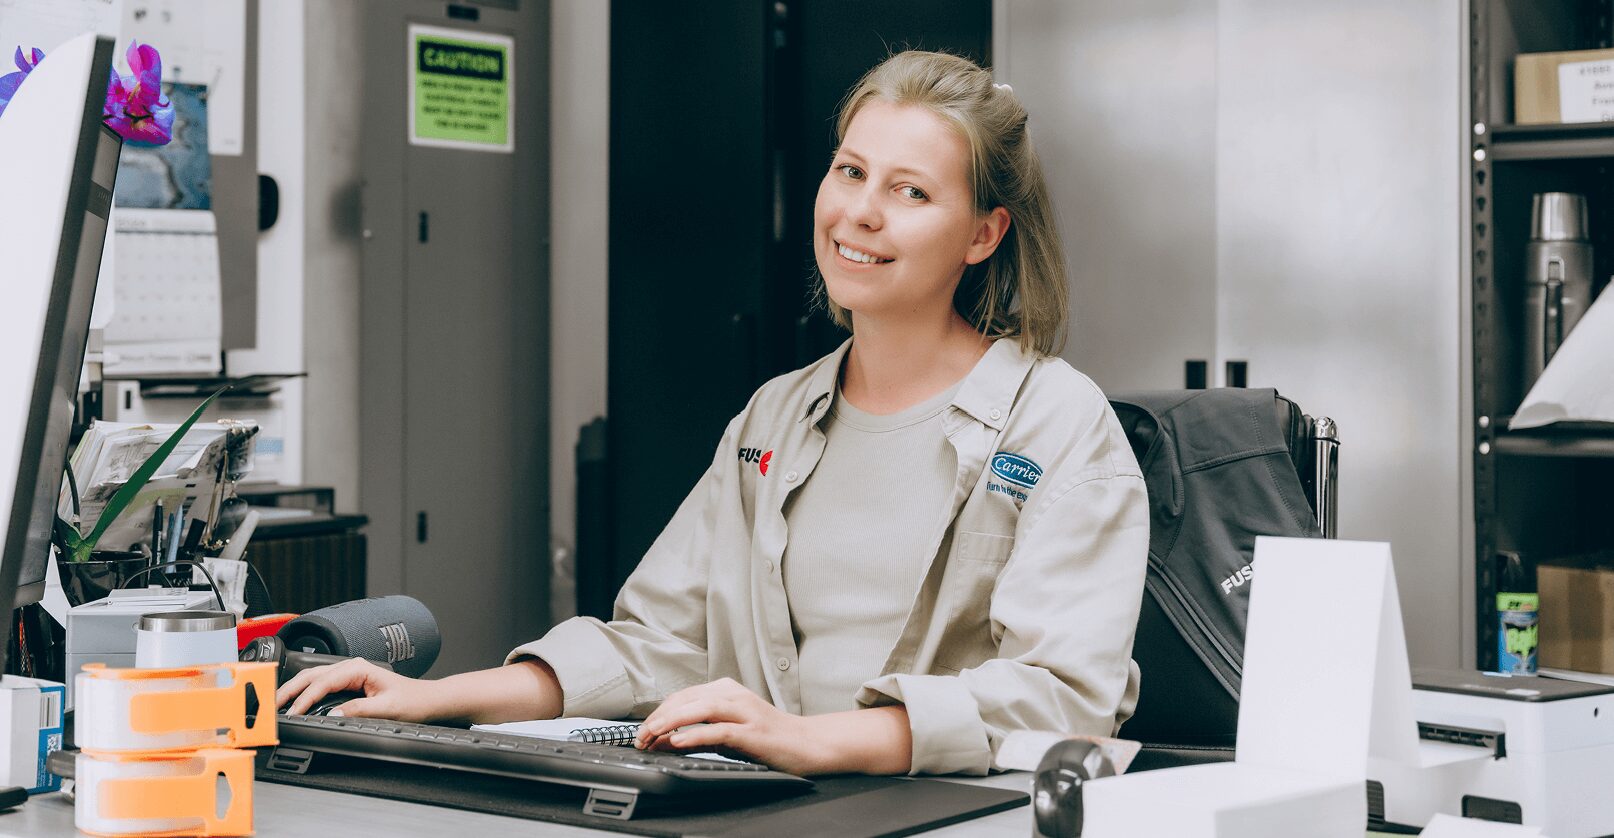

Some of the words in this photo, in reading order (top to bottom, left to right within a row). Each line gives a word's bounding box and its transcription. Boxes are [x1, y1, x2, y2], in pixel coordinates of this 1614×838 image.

[423, 47, 500, 73] CAUTION
[995, 458, 1040, 482] Carrier
[1220, 560, 1254, 595] FUS
